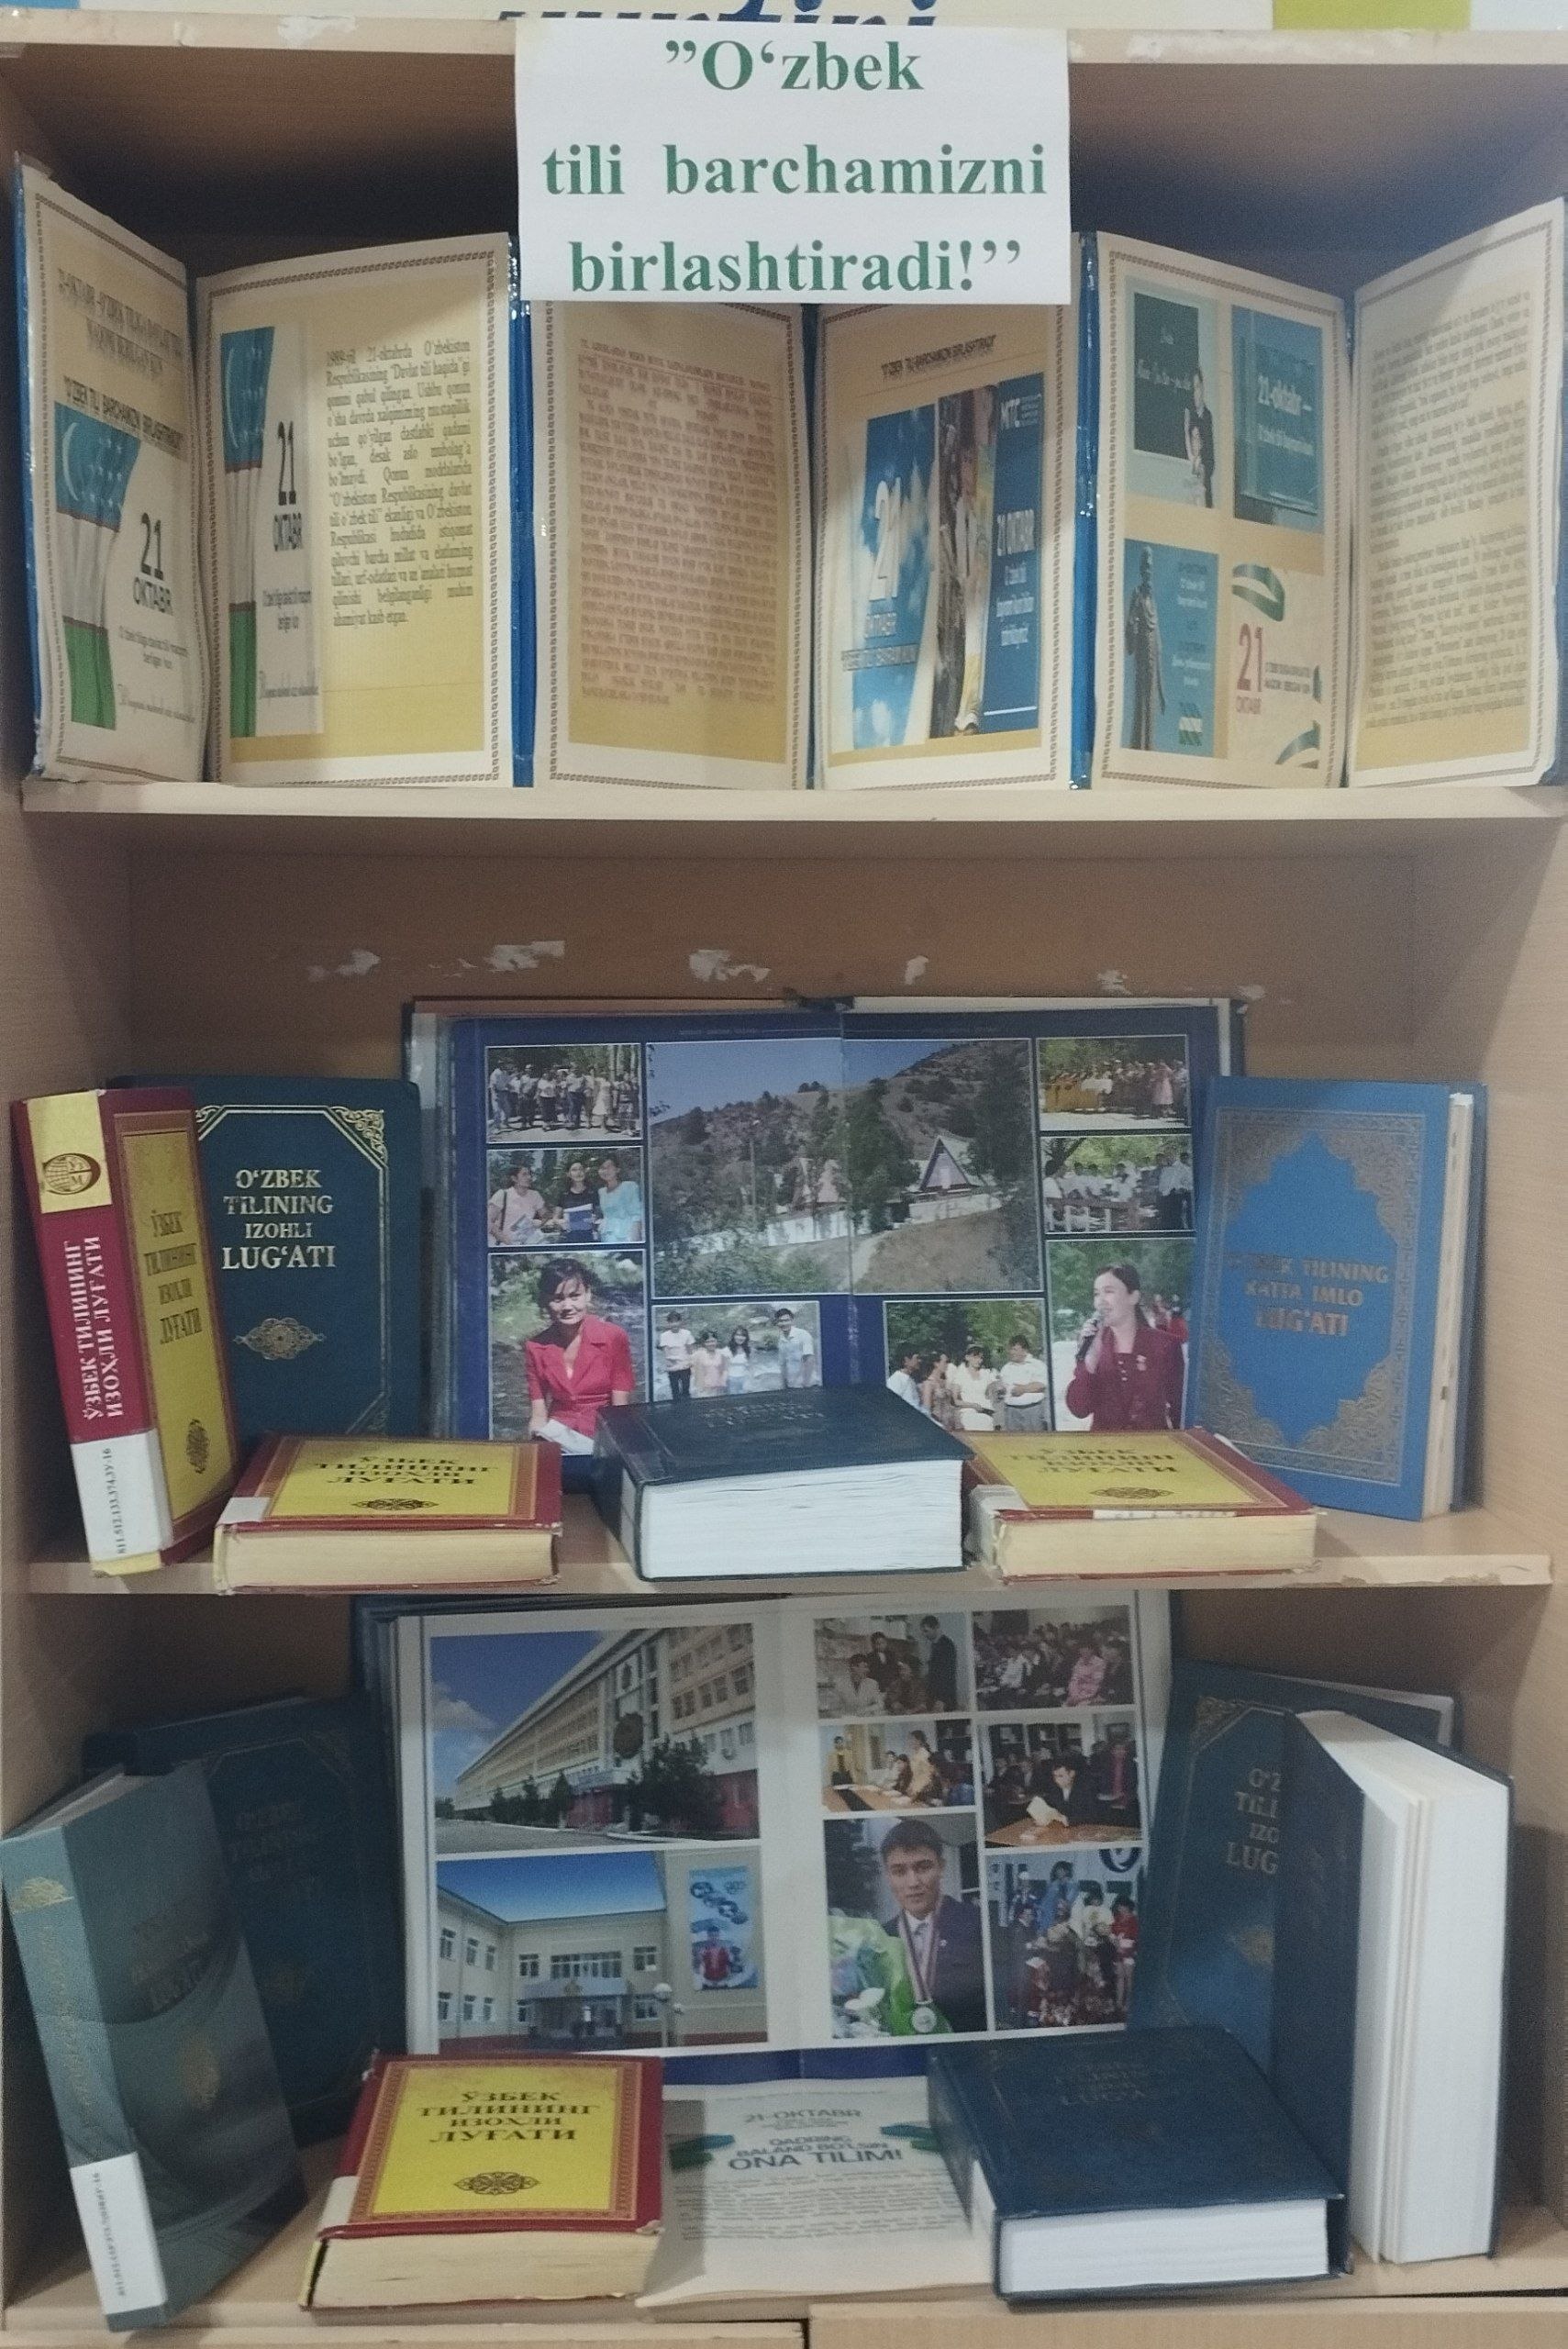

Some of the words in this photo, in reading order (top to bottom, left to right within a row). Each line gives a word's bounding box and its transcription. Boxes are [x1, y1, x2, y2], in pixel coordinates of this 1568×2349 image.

[542, 144, 625, 195] tili
[662, 143, 1047, 195] barchamizni
[277, 421, 296, 506] 21
[140, 513, 163, 580] 21
[1237, 623, 1262, 692] 21
[223, 1196, 334, 1215] TILINING
[245, 1222, 314, 1239] IZOHLI
[63, 1241, 95, 1354] ТИЛИНИНГ
[80, 1357, 104, 1420] ЎЗБЕК
[728, 2154, 800, 2171] ONA
[809, 2148, 903, 2165] TILIM!
[736, 2143, 812, 2157] BALAND
